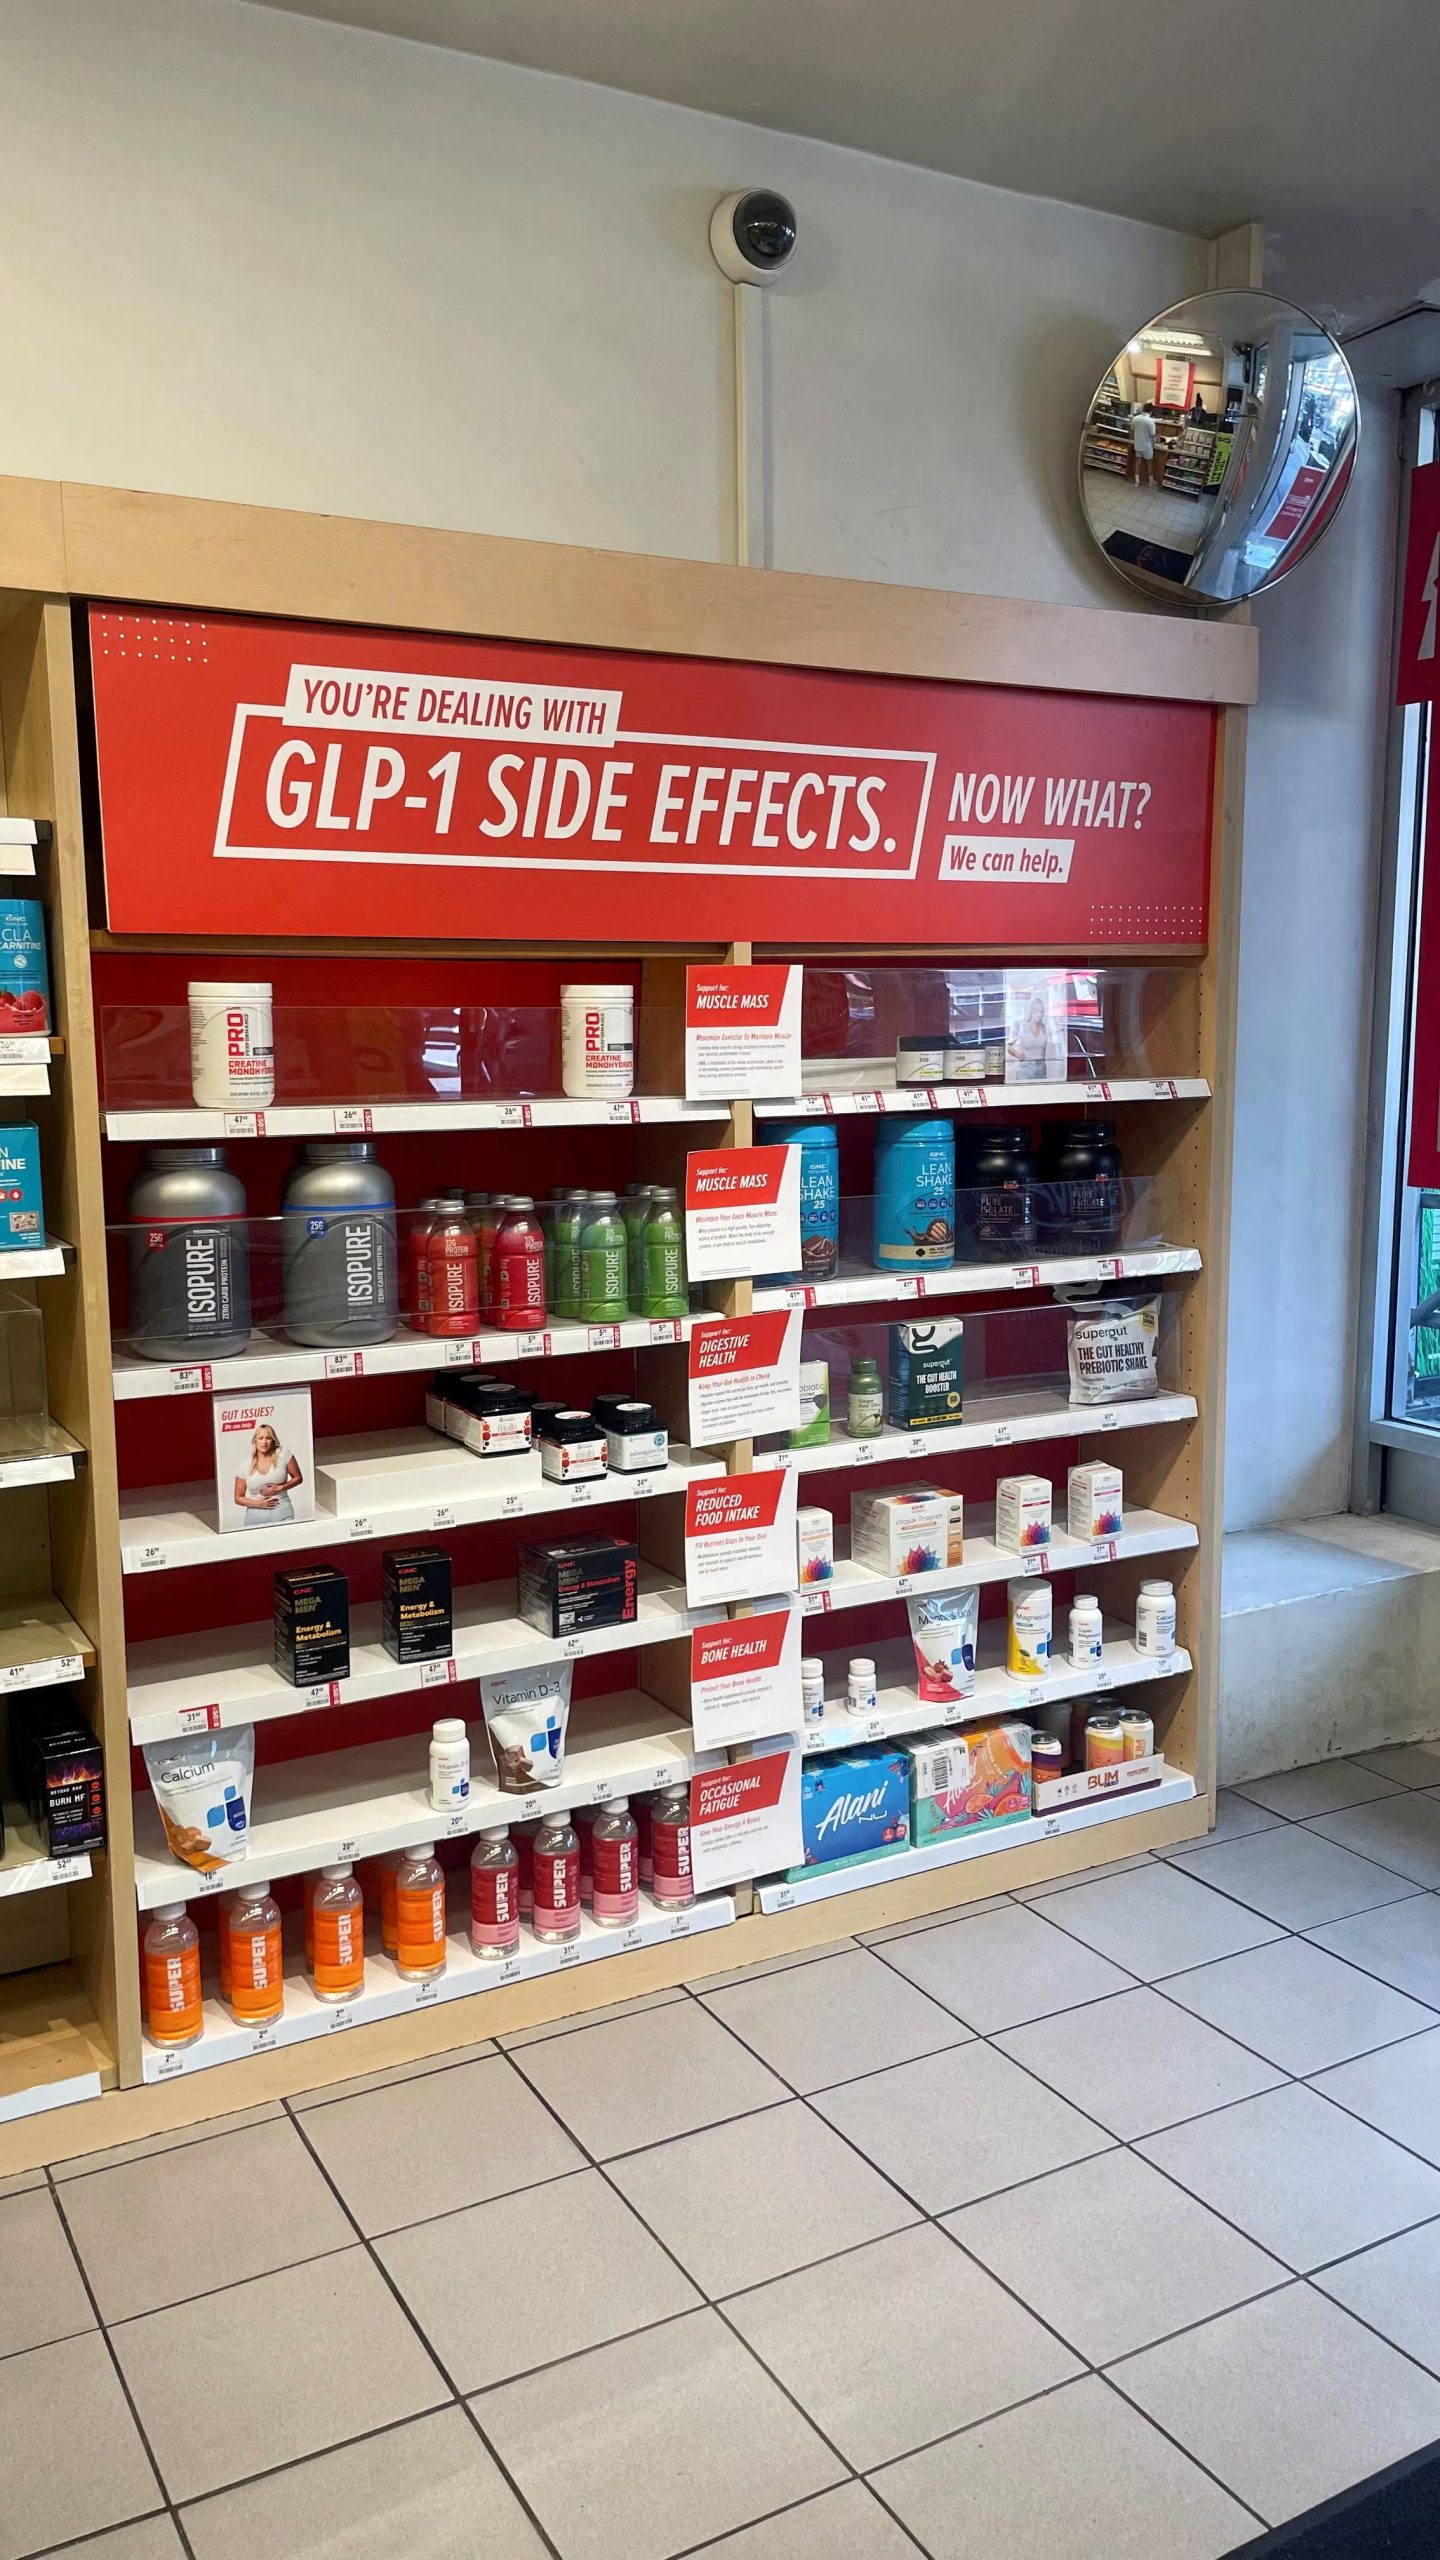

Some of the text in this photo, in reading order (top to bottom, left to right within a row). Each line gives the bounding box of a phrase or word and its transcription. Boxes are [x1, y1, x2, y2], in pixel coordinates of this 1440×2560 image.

[417, 688, 533, 731] DEALING
[543, 700, 608, 735] WITH
[265, 738, 897, 853] GLP-1 SIDE EFFECTS.
[947, 772, 1153, 831] NOW WHAT?
[949, 846, 1063, 879] We can help.
[1, 929, 32, 941] CLA
[697, 984, 718, 993] Support
[696, 995, 770, 1009] MUSCLE MASS
[227, 1013, 244, 1056] PRO
[586, 1012, 600, 1052] PRO
[229, 1060, 267, 1068] CREATINE
[586, 1055, 621, 1063] CREATINE
[696, 1168, 718, 1177] Support
[922, 1163, 951, 1175] LEAN
[696, 1174, 769, 1193] MUSCLE MASS
[801, 1175, 833, 1188] LEAN
[916, 1173, 953, 1187] SHAKE
[933, 1186, 944, 1196] 25
[813, 1200, 826, 1210] 25
[345, 1225, 373, 1303] ISOPURE
[605, 1249, 620, 1298] ISOPURE
[665, 1248, 678, 1297] ISOPURE
[186, 1238, 216, 1319] ISOPURE
[447, 1263, 463, 1312] ISOPURE
[527, 1258, 540, 1306] ISOPURE
[1076, 1326, 1128, 1341] supergut
[700, 1335, 750, 1353] DIGESTIVE
[1077, 1341, 1145, 1361] THE GUT HEALTHY
[699, 1351, 736, 1368] HEALTH
[923, 1359, 951, 1370] supergut
[1079, 1356, 1148, 1375] PREBIOTIC SHAKE
[917, 1371, 957, 1385] THE GUT HEALTH
[925, 1383, 950, 1394] BOOSTER
[222, 1406, 274, 1421] GUT ISSUES?
[695, 1494, 742, 1513] REDUCED
[695, 1505, 760, 1527] FOOD INTAKE
[400, 1576, 425, 1587] MEGA
[622, 1559, 637, 1620] Energy
[295, 1596, 321, 1607] MEGA
[400, 1603, 427, 1613] Energy
[400, 1608, 445, 1620] Metabolism
[296, 1623, 324, 1634] Energy
[296, 1628, 341, 1642] Metabolism
[701, 1639, 768, 1664] BONE HEALTH
[493, 1681, 561, 1706] Vitamin D-3
[161, 1760, 215, 1784] Calcium
[1088, 1770, 1119, 1789] BUM
[700, 1776, 761, 1802] OCCASIONAL
[50, 1794, 86, 1808] BURN MF
[699, 1794, 740, 1816] FATIGUE
[815, 1780, 889, 1842] Alani
[858, 1811, 888, 1825] NU
[677, 1827, 690, 1877] SUPER
[620, 1841, 632, 1893] SUPER
[553, 1859, 567, 1909] SUPER
[496, 1872, 510, 1923] SUPER
[432, 1890, 444, 1943] SUPER
[338, 1914, 353, 1966] SUPER
[251, 1935, 267, 1990] SUPER
[167, 1957, 185, 2013] SUPER
